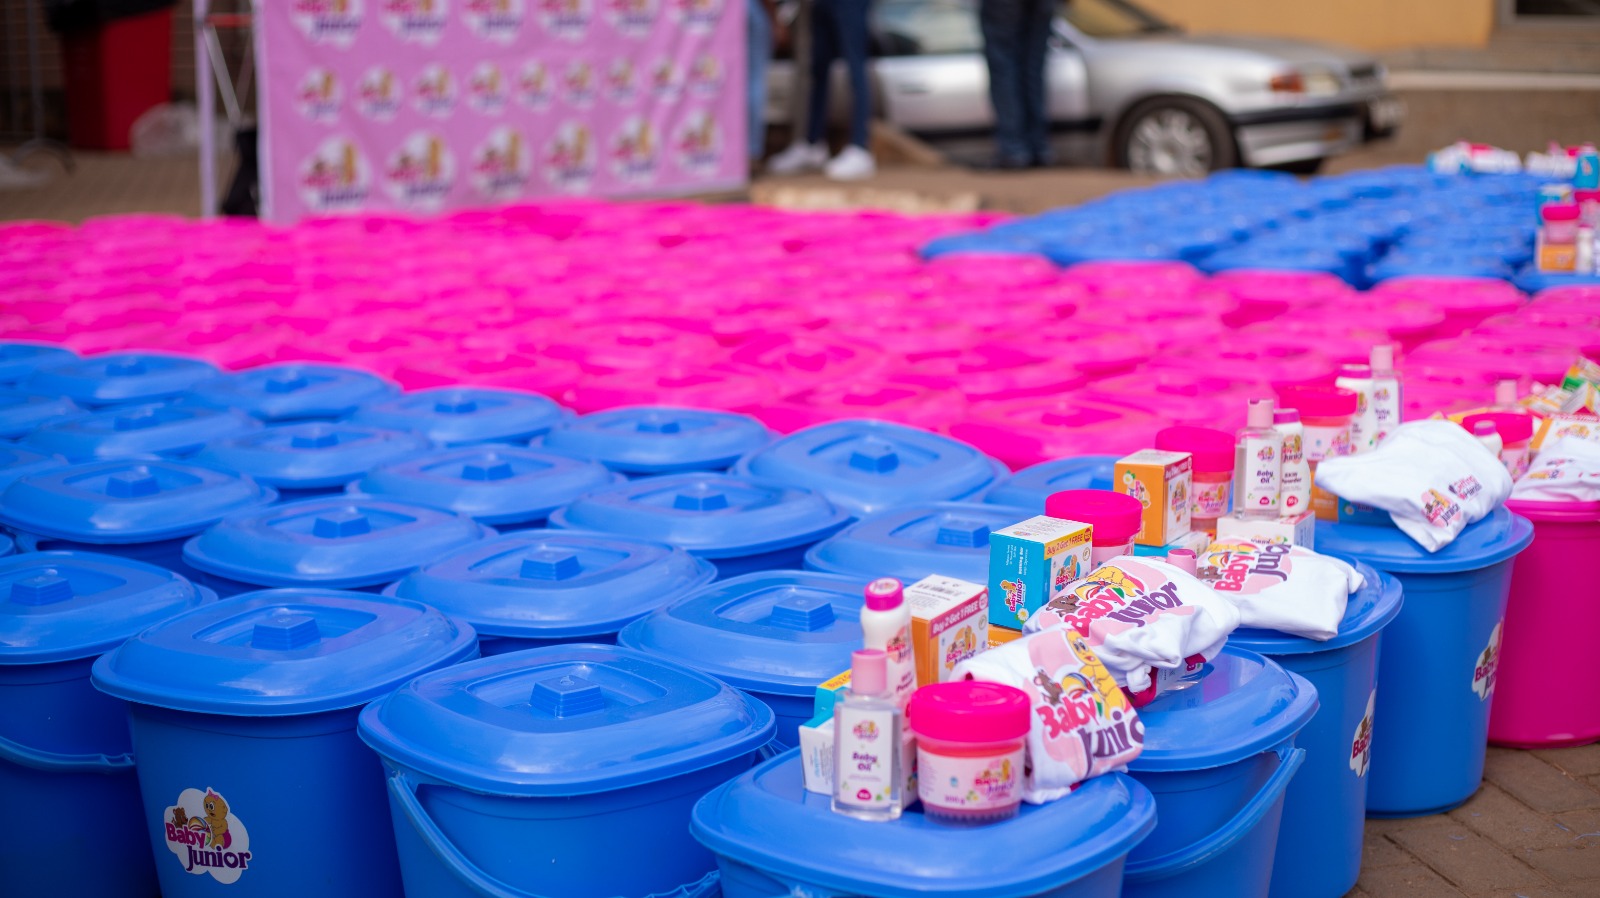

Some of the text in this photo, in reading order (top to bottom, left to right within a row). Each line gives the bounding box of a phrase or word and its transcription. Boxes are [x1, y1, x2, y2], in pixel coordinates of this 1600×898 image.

[1213, 554, 1255, 592] Baby
[1009, 593, 1017, 612] Baby
[1064, 588, 1126, 638] Baby
[1107, 581, 1183, 628] Junior
[166, 822, 206, 849] Baby
[186, 845, 251, 871] Junior
